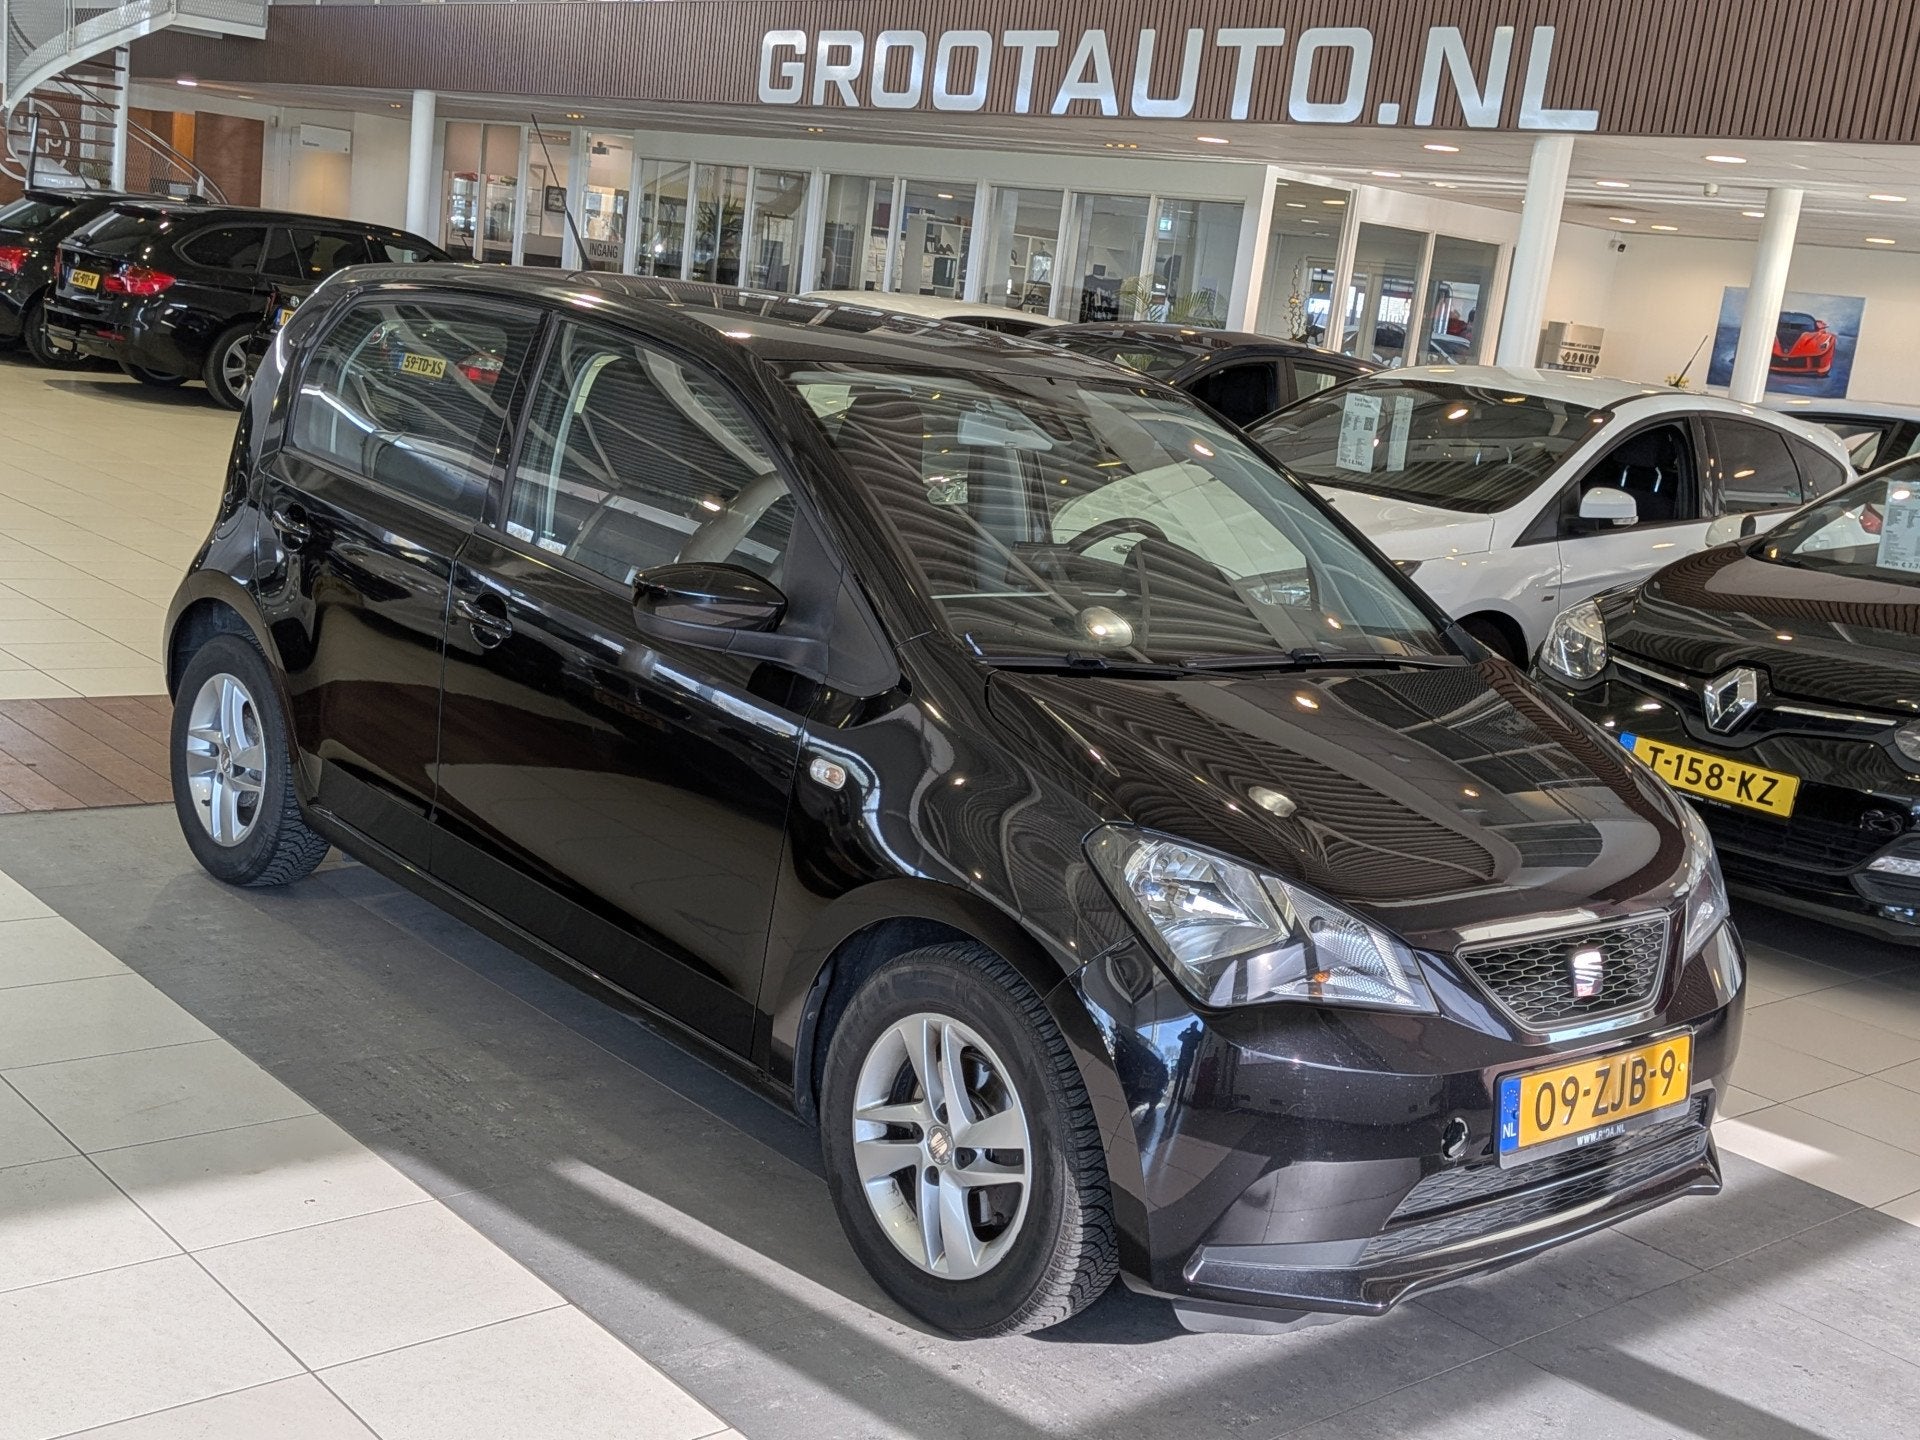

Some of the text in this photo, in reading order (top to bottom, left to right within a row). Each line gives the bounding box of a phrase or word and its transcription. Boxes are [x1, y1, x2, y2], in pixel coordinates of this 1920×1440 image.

[758, 25, 1600, 131] GROOTAUTO.NL
[589, 242, 619, 259] INGANG
[404, 355, 443, 376] 59-TD-XS
[1648, 745, 1780, 807] T-158-KZ
[1535, 1048, 1677, 1132] 09-ZJB-9
[1502, 1122, 1517, 1139] NL
